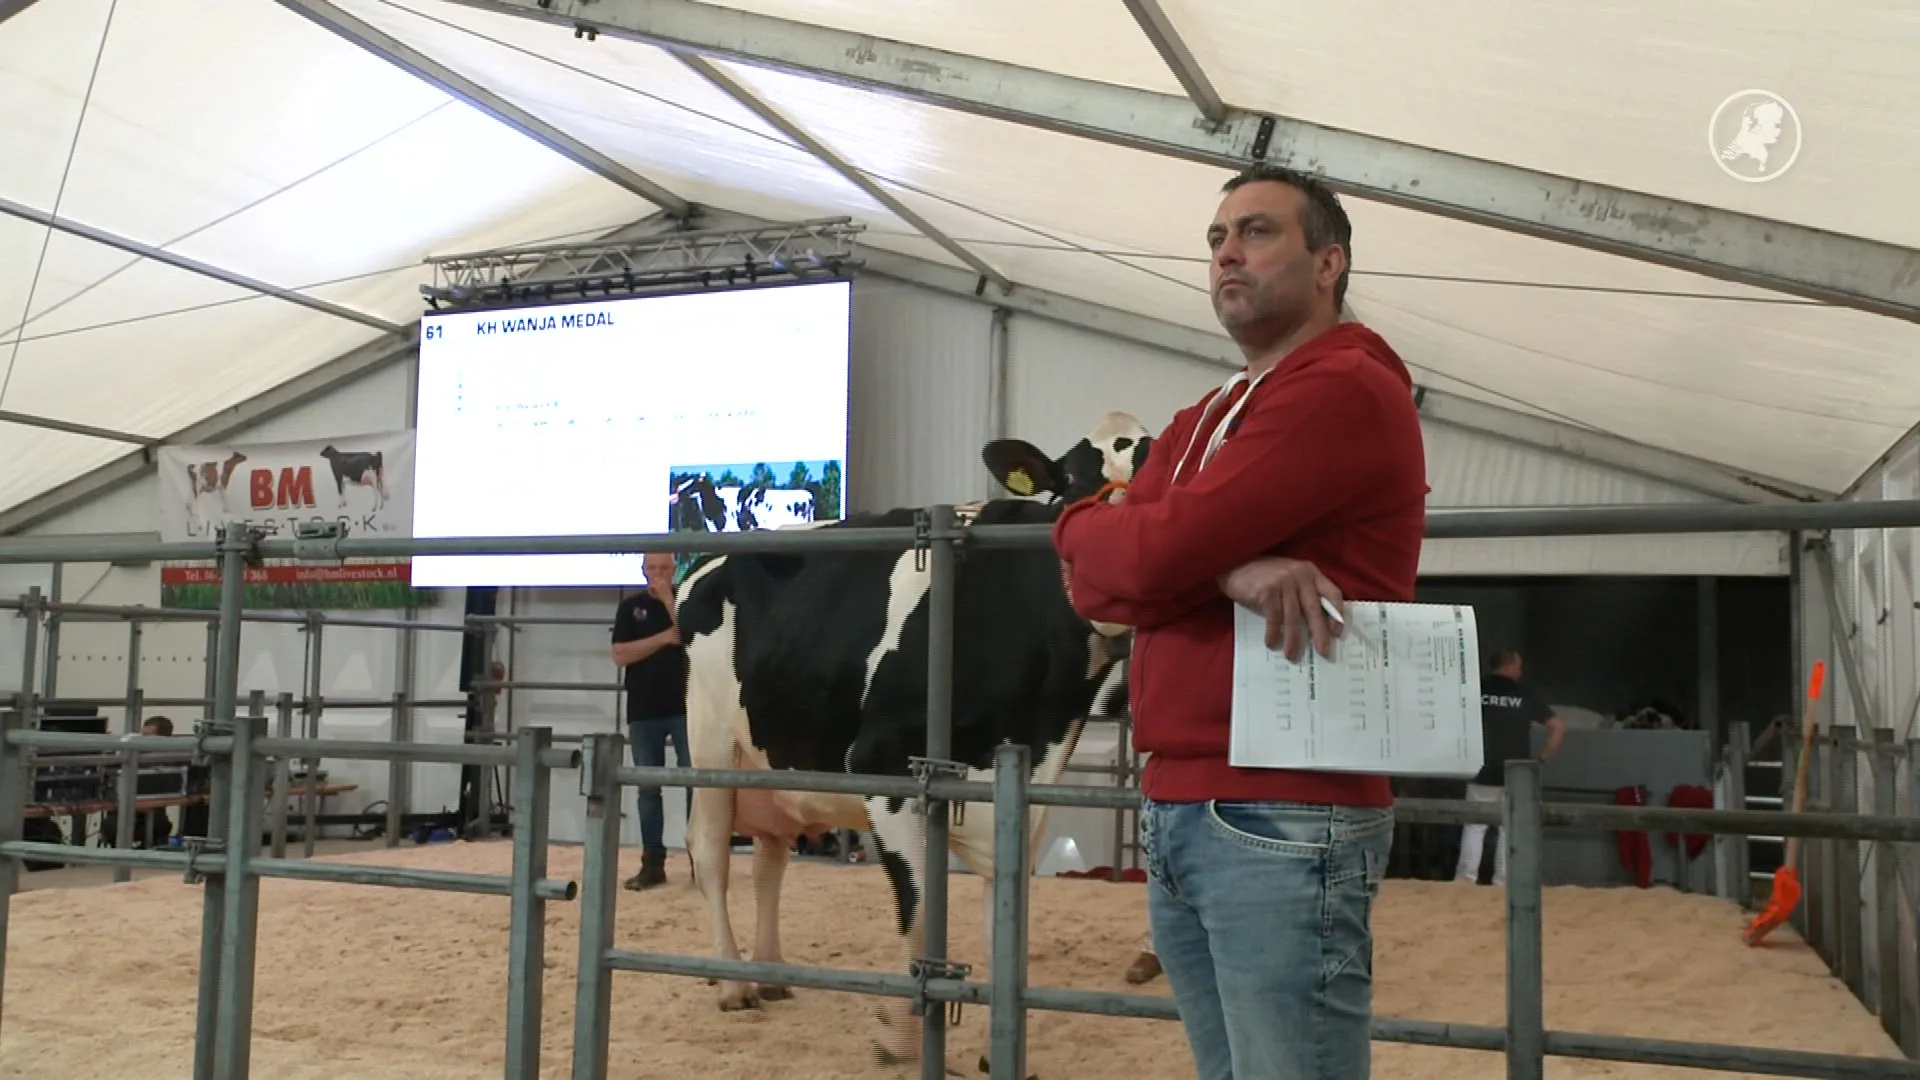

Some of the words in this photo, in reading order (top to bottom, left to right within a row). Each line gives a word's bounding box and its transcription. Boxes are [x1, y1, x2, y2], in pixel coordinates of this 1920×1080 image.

[426, 325, 443, 340] 61
[476, 321, 497, 335] KH
[502, 316, 556, 333] WANJA
[561, 312, 615, 328] MEDAL
[249, 465, 316, 511] BM
[1480, 694, 1523, 708] CREW
